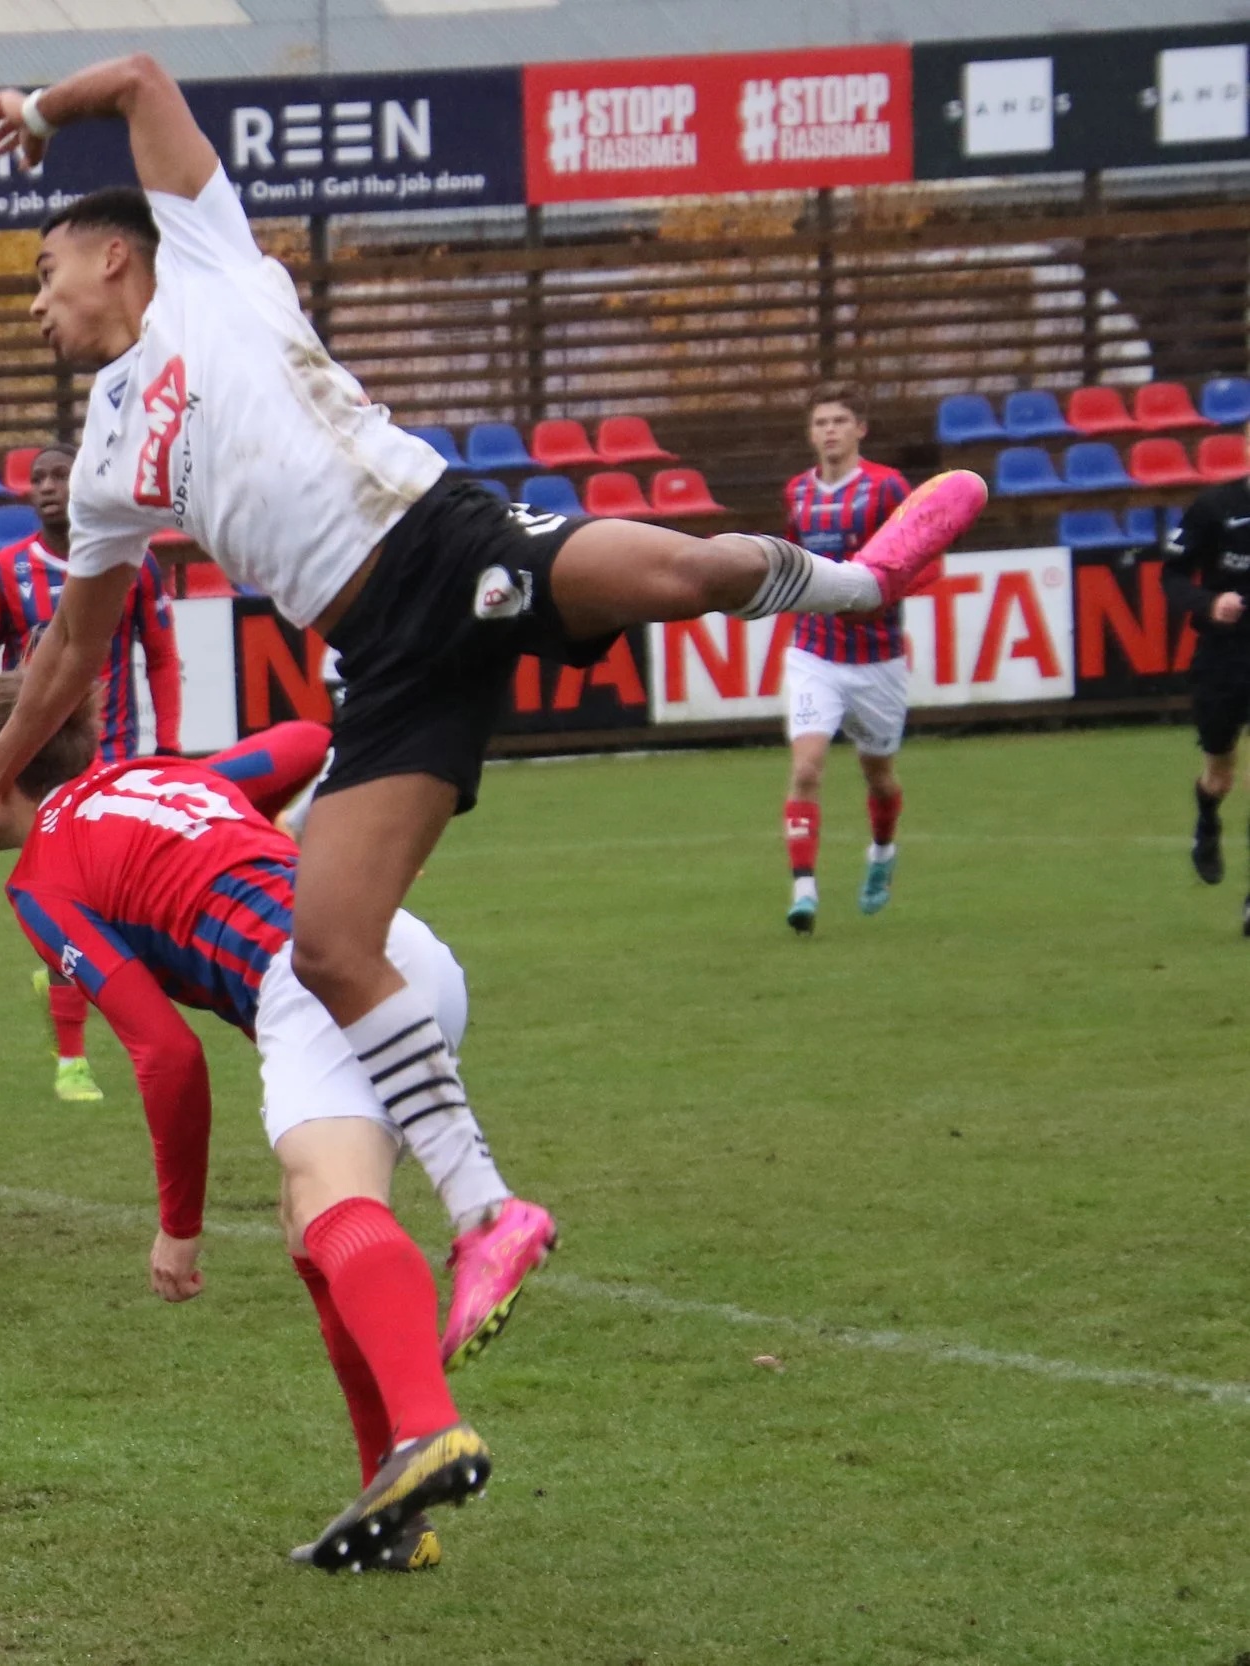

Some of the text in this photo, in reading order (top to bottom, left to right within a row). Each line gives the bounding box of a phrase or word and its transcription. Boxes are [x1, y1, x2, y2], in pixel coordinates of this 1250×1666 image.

[231, 98, 431, 167] REEN
[548, 84, 696, 173] #STOPP
[739, 73, 890, 163] #STOPP
[587, 133, 697, 171] RASISMEN
[779, 122, 890, 159] RASISMEN
[10, 190, 44, 215] job
[252, 180, 296, 199] Own
[300, 178, 314, 197] it
[323, 177, 359, 196] Get
[363, 175, 395, 194] the
[398, 173, 431, 197] job
[435, 171, 485, 190] done
